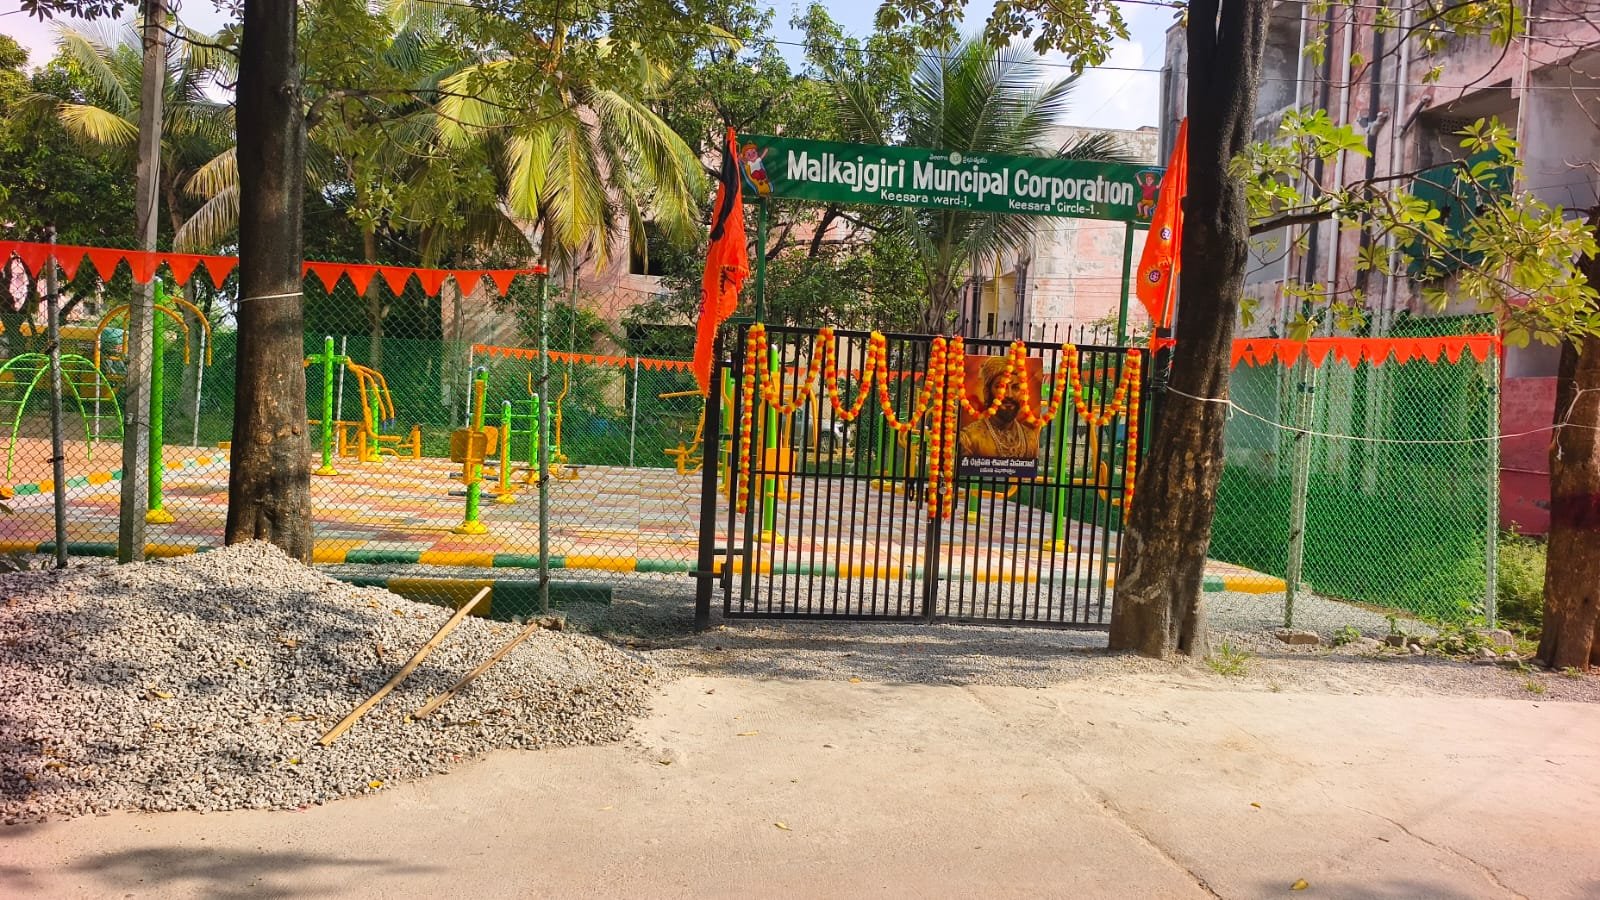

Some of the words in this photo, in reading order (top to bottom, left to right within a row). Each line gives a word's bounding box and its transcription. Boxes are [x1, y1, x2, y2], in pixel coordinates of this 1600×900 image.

[787, 150, 906, 193] Malkajgiri
[913, 160, 1009, 202] Muncipal
[1014, 168, 1134, 206] Corporation
[880, 189, 929, 203] Keesara
[1008, 198, 1051, 212] Keesara
